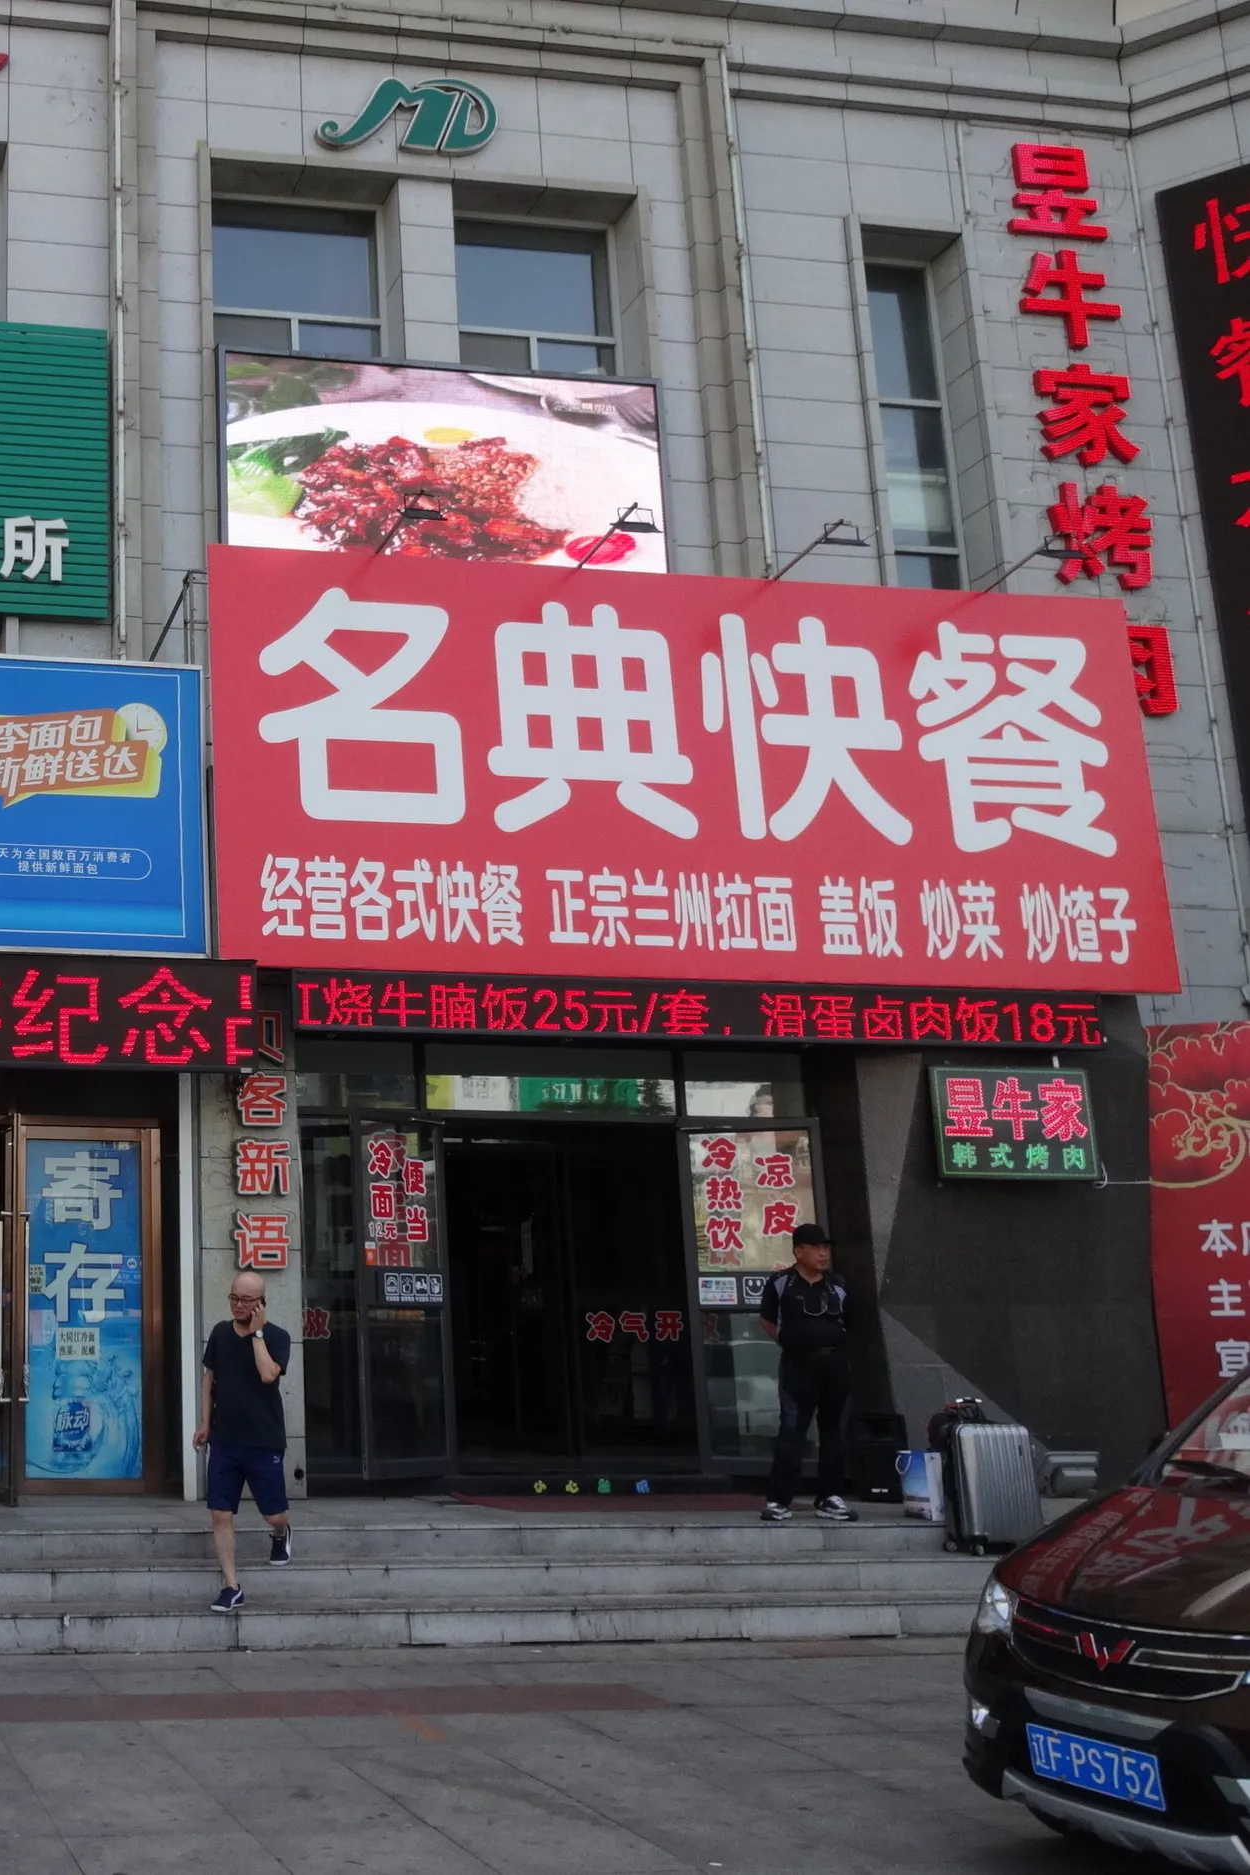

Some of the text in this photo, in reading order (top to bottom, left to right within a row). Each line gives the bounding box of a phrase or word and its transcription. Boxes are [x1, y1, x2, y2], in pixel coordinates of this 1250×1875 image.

[257, 586, 1118, 858] 名典快餐
[17, 860, 99, 875] 提供新鲜面包
[260, 853, 524, 946] 经营各式快餐
[546, 866, 797, 951] 正宗兰州拉面
[819, 876, 903, 958] 盖饭
[920, 878, 1003, 961] 炒菜
[945, 1076, 1089, 1142] 昱牛家
[367, 1140, 395, 1220] 冷面
[701, 1137, 745, 1251] 冷热饮
[754, 1153, 798, 1236] 凉皮
[952, 1142, 1087, 1170] 韩式烤肉
[42, 1152, 125, 1323] 寄存
[402, 1159, 429, 1242] 便当
